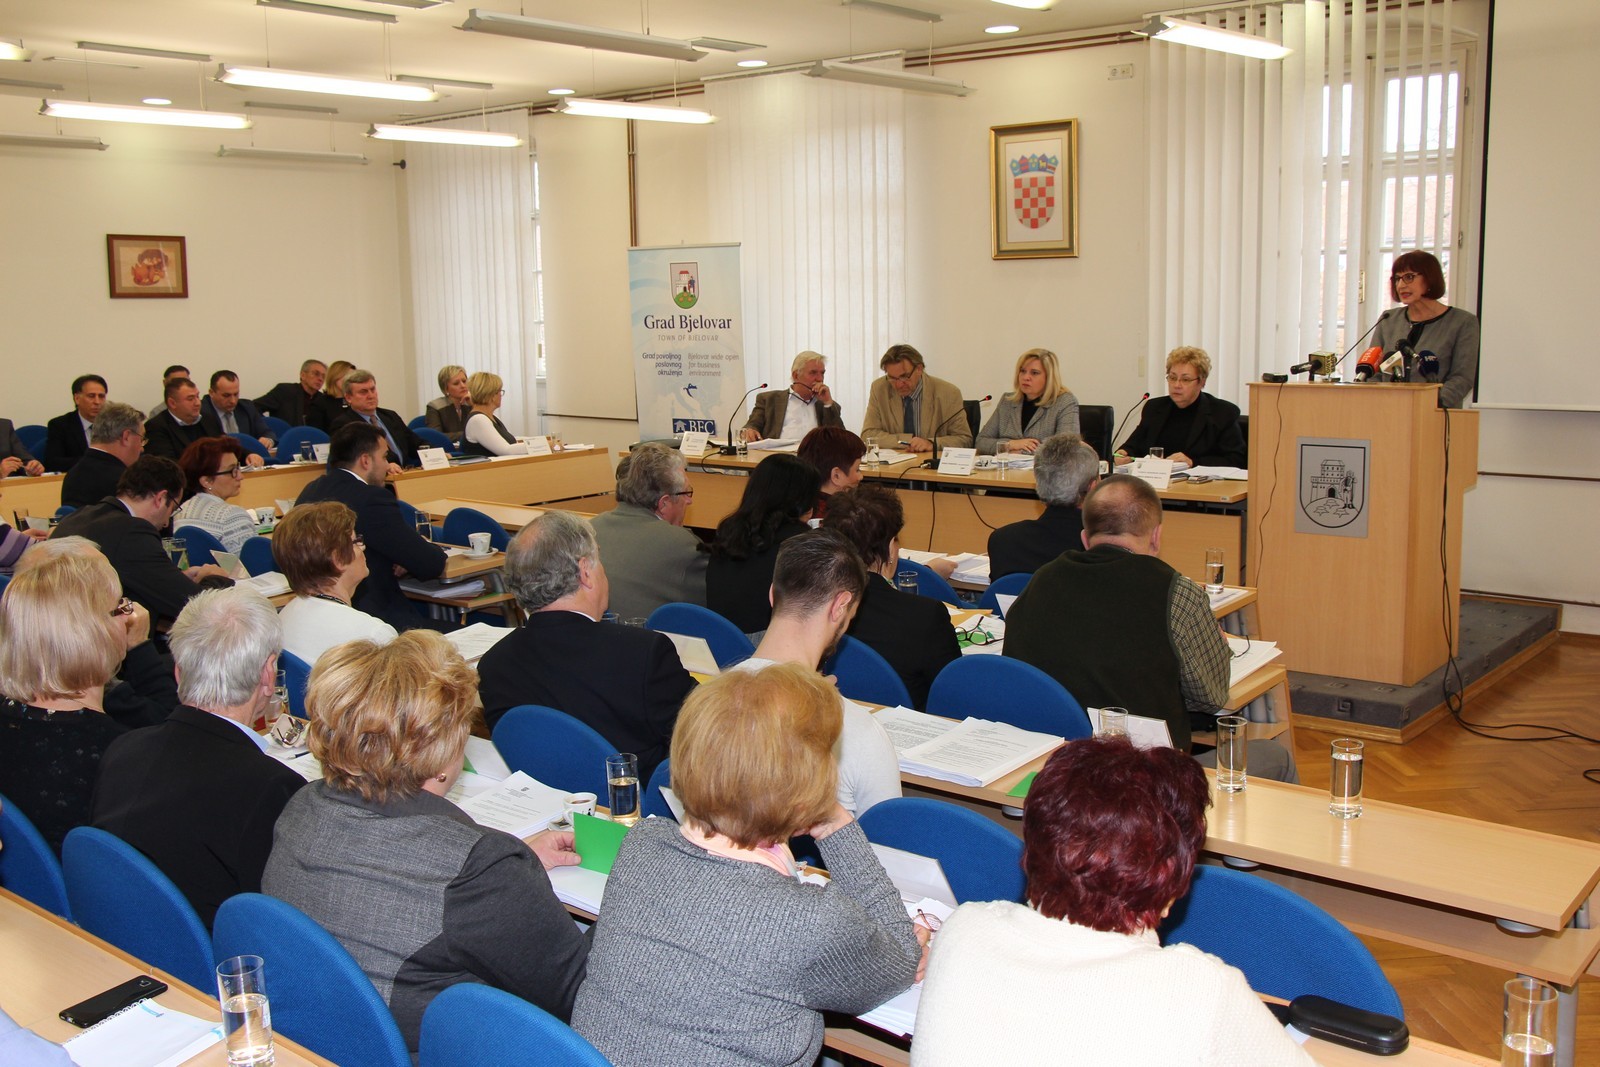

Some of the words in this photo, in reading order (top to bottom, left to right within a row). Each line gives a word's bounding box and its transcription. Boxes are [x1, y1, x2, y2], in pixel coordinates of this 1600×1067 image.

[644, 315, 675, 330] Grad
[679, 315, 732, 332] Bjelovar
[656, 353, 682, 361] povoljnog
[688, 353, 710, 361] Bjelovar
[655, 361, 682, 369] poslovnog
